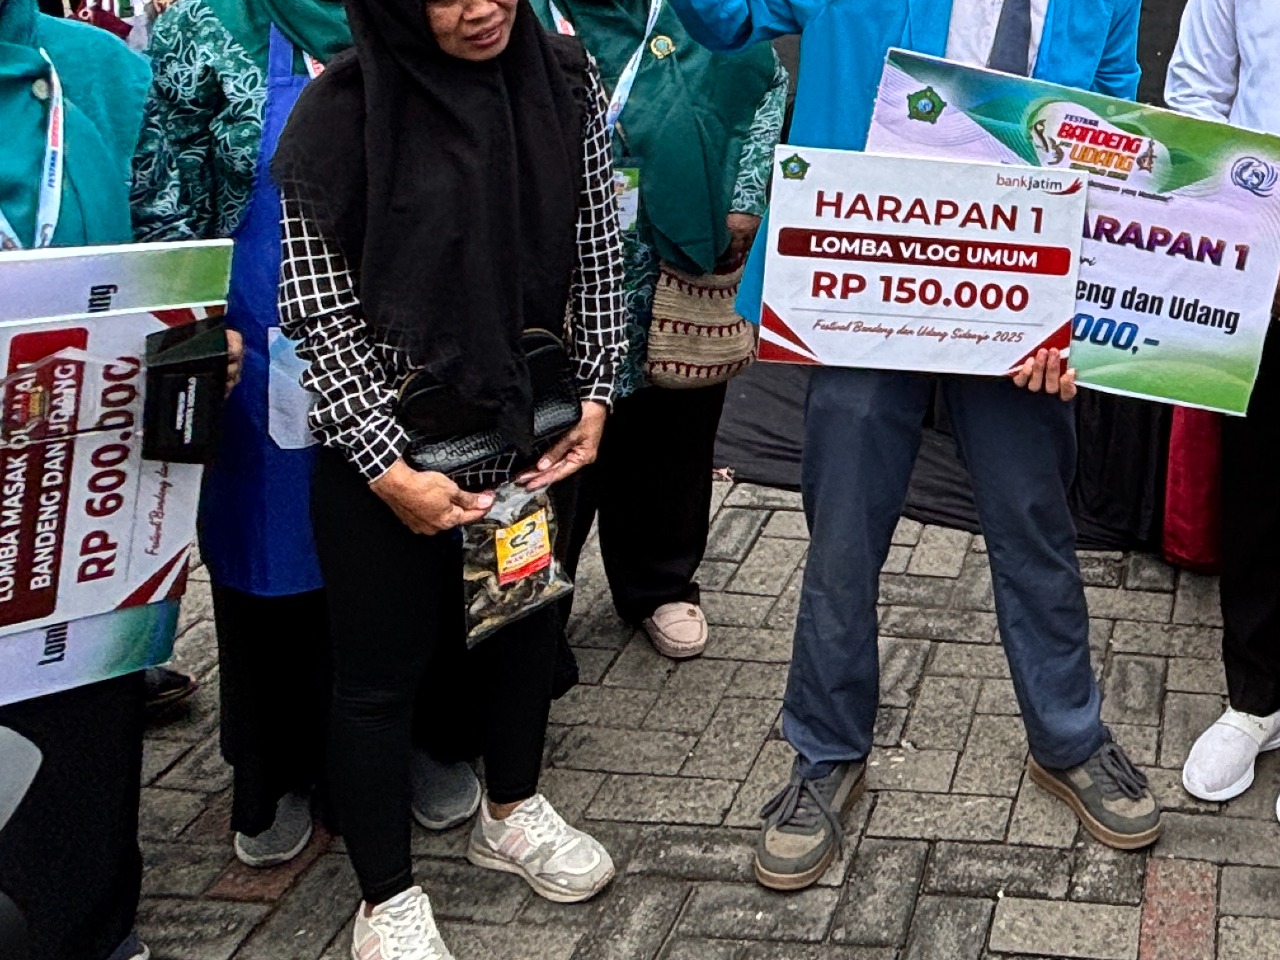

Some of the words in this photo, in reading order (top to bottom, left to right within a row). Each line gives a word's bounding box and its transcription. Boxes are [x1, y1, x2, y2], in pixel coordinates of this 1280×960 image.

[1057, 122, 1143, 154] BANDENG
[1069, 144, 1136, 172] UDANG
[815, 190, 1019, 232] HARAPAN
[1031, 207, 1044, 234] 1
[810, 235, 893, 257] LOMBA
[899, 242, 960, 262] VLOG
[966, 248, 1038, 268] UMUM
[1234, 244, 1251, 272] 1
[811, 271, 867, 300] RP
[879, 275, 1029, 312] 150.000
[1076, 279, 1117, 310] eng
[1120, 286, 1165, 316] dan
[1168, 295, 1241, 335] Udang
[991, 331, 1025, 343] 2025
[85, 356, 141, 517] 600.000
[42, 440, 67, 488] DAN
[1, 453, 29, 527] MASAK
[30, 491, 62, 591] BANDENG
[77, 530, 118, 583] RP
